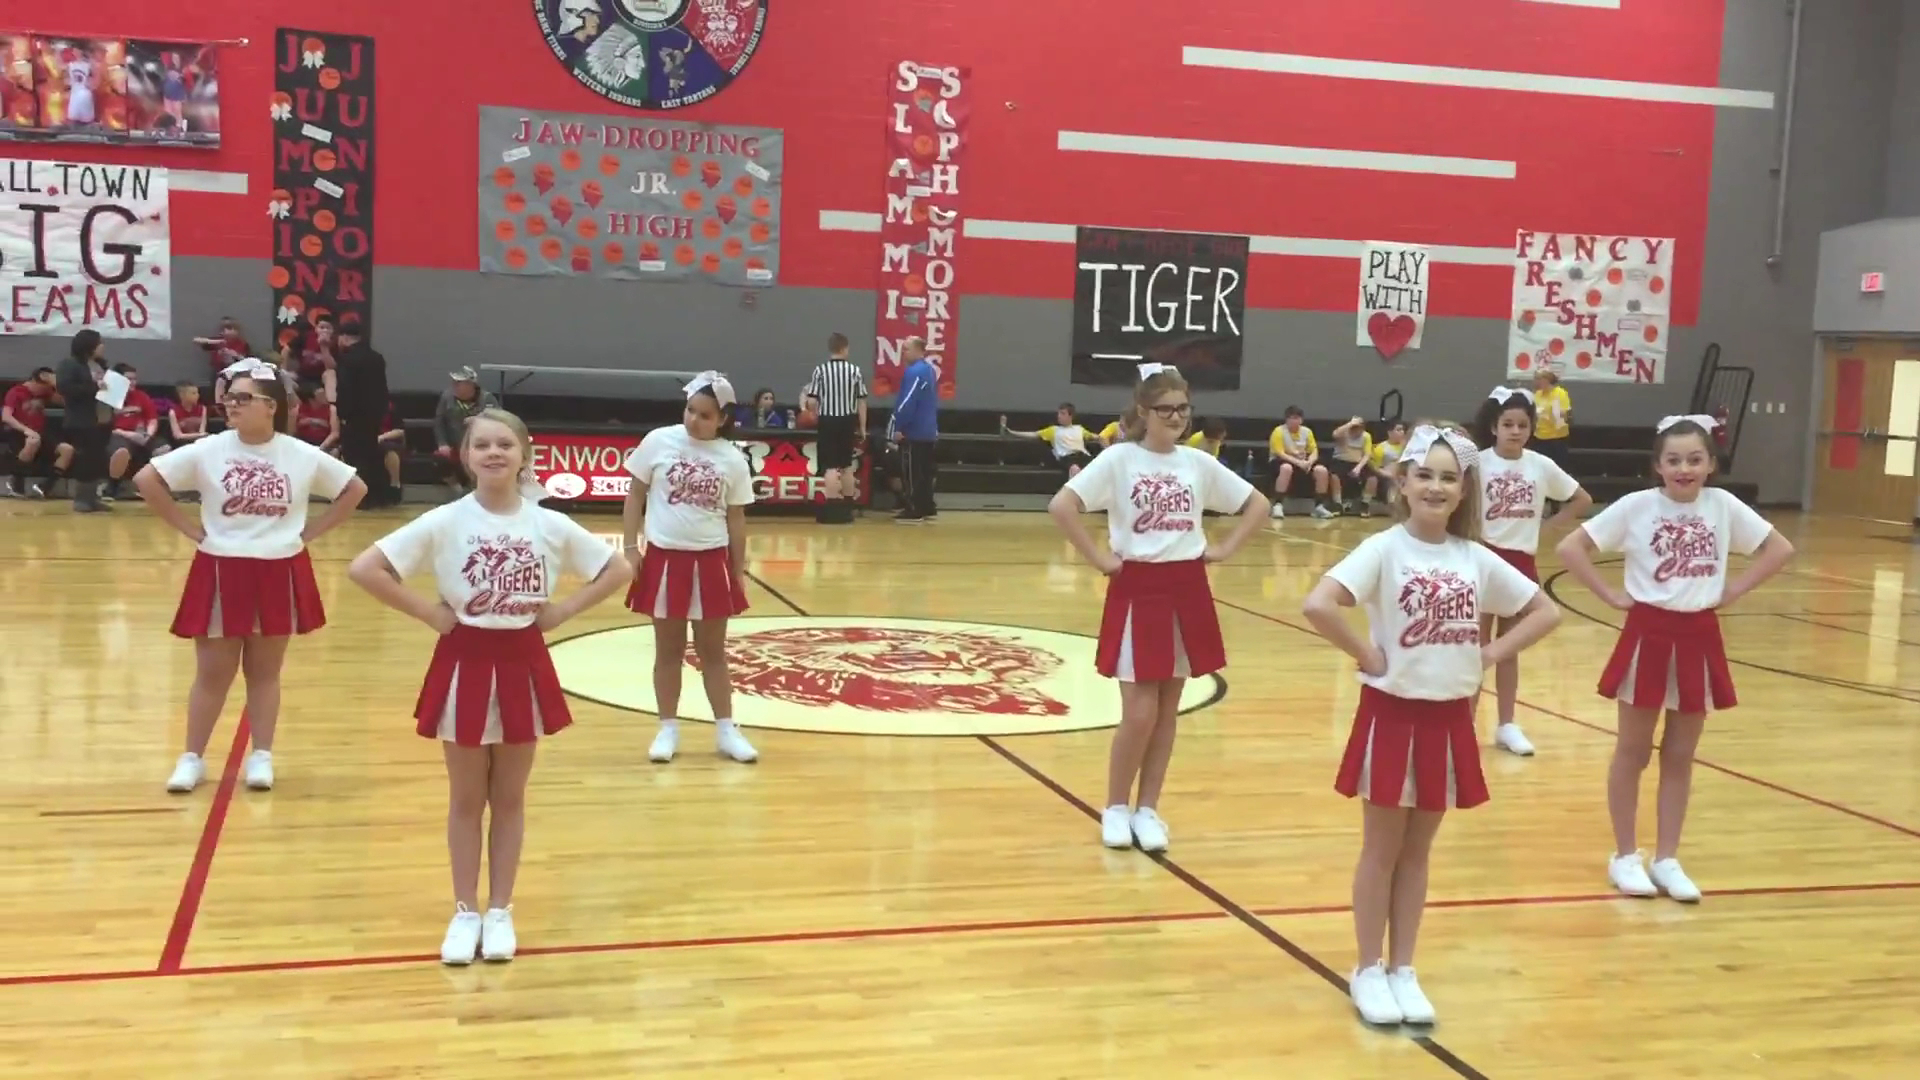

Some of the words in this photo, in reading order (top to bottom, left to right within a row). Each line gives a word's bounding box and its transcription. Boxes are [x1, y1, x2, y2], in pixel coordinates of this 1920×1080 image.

[573, 65, 606, 95] WESTERN
[608, 90, 641, 107] INDIANS
[661, 98, 681, 109] EAST
[683, 85, 716, 105] TARTANS
[512, 118, 761, 158] JAW-DROPPING
[0, 161, 41, 192] LL
[54, 164, 150, 200] TOWN
[332, 42, 369, 323] JUNIOR
[630, 171, 677, 195] JR.
[606, 211, 695, 239] HIGH
[877, 61, 918, 366] SLAMMIN
[0, 204, 142, 285] IG
[1516, 232, 1663, 265] FANCY
[1368, 250, 1425, 284] PLAY
[0, 284, 148, 328] EAMS
[1079, 262, 1240, 336] TIGER
[1362, 284, 1423, 314] WITH
[241, 478, 284, 499] TIGERS
[1152, 489, 1190, 512] TIGERS
[221, 495, 288, 516] Cheer
[1132, 511, 1195, 534] Cheer
[490, 562, 541, 592] TIGERS
[1425, 587, 1474, 620] TIGERS
[1399, 619, 1479, 648] Cheer
